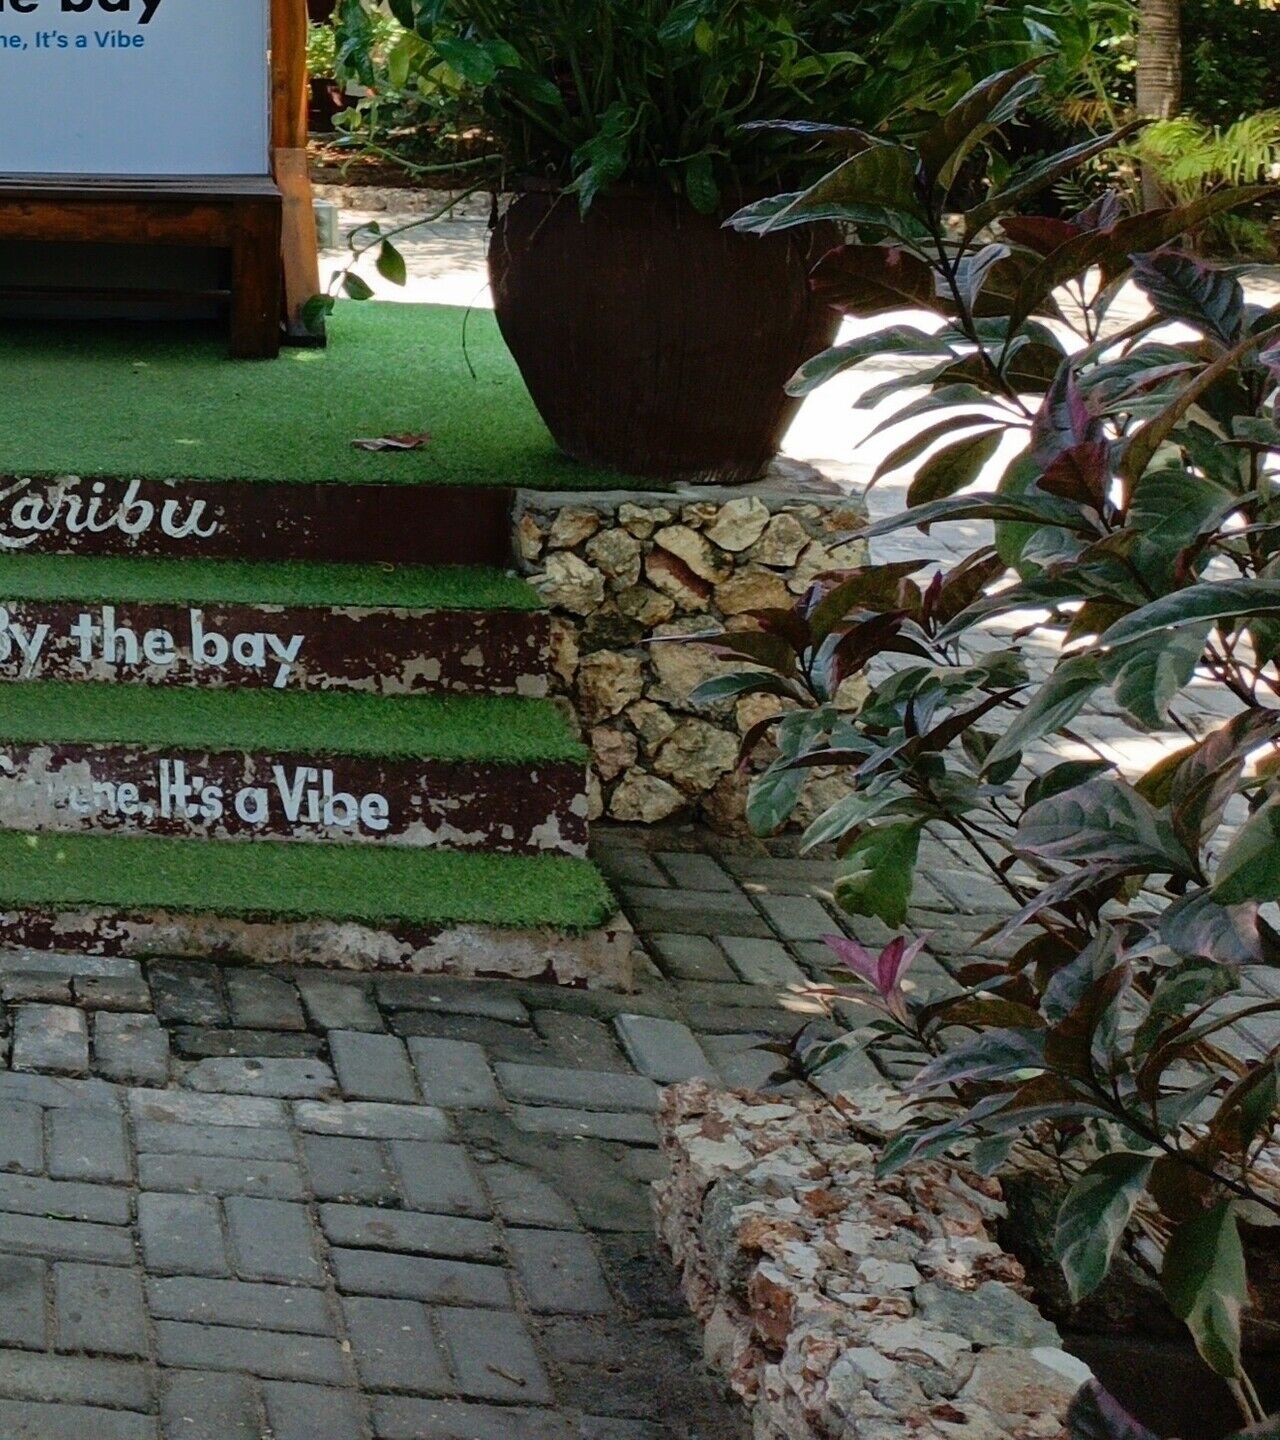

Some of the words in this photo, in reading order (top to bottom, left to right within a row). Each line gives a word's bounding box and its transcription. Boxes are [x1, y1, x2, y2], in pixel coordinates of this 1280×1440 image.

[36, 30, 68, 48] It's
[75, 36, 87, 48] a
[94, 30, 145, 48] Vibe
[71, 606, 176, 665] the
[190, 608, 305, 688] bay
[159, 759, 224, 819] It's
[235, 787, 269, 823] a
[273, 765, 390, 831] Vibe
